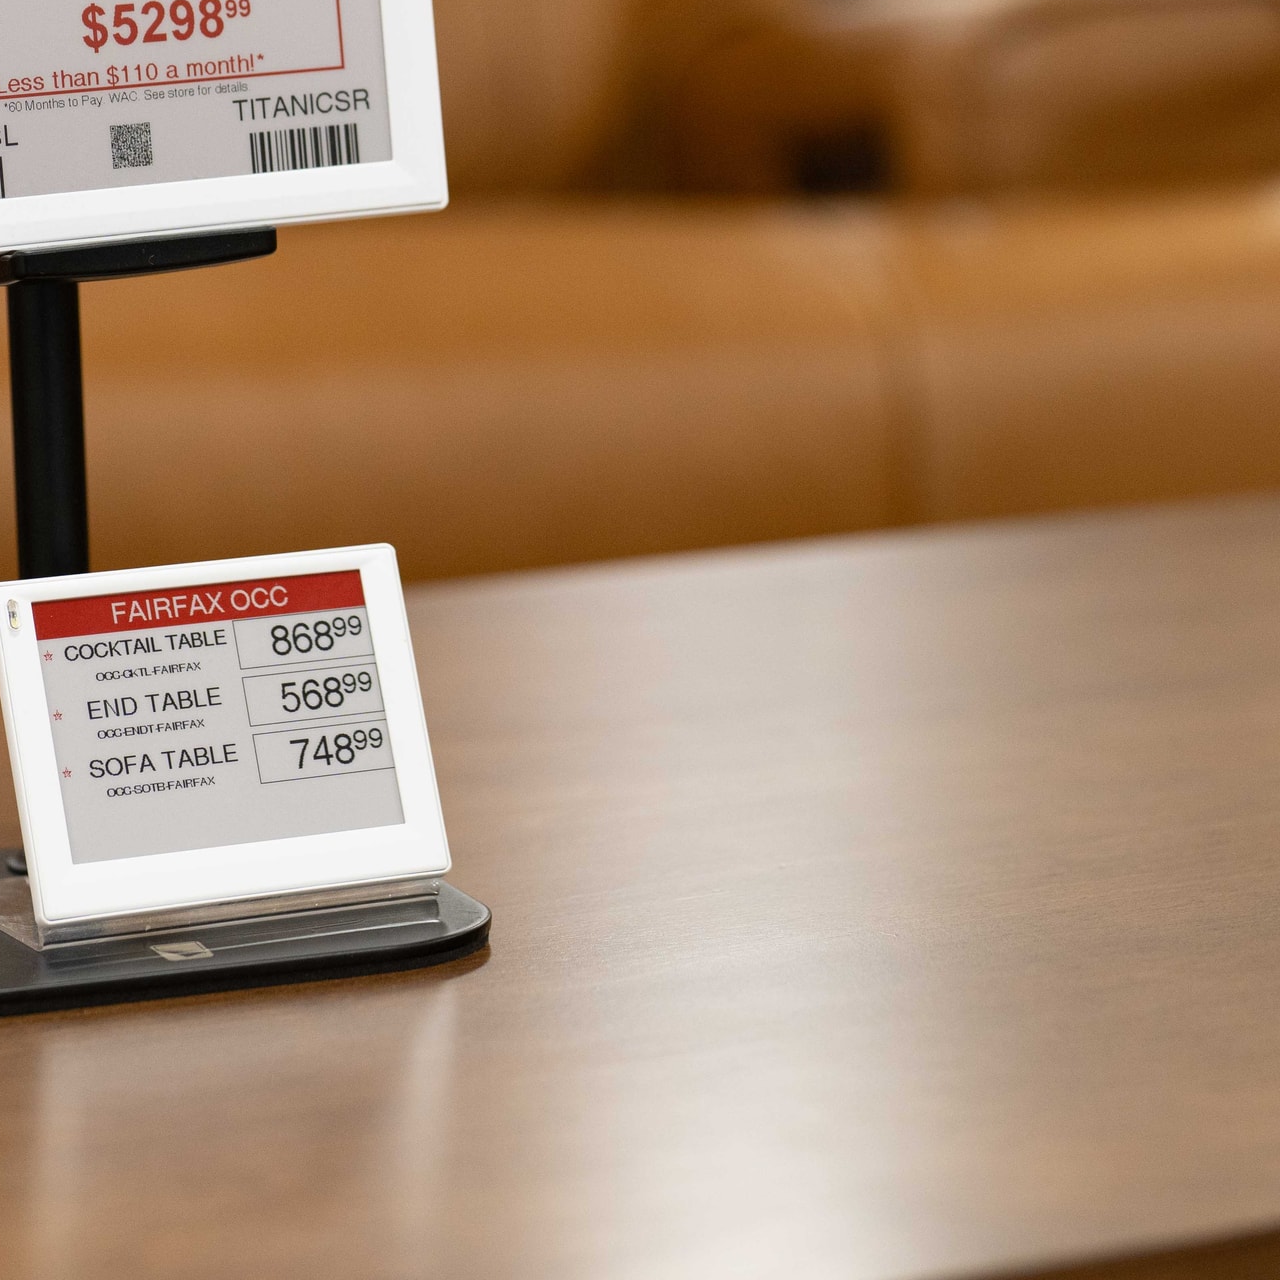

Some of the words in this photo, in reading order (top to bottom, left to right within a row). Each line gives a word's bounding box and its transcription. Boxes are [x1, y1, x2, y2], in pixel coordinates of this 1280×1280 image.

[52, 70, 99, 88] than
[107, 61, 159, 87] $110
[167, 65, 178, 78] a
[25, 99, 65, 110] Months
[68, 98, 78, 107] to
[144, 90, 165, 101] See
[168, 88, 194, 99] store
[198, 85, 211, 95] for
[232, 89, 370, 121] TITANICSR
[112, 592, 225, 624] FAIRFAX
[231, 586, 288, 610] OCC
[64, 637, 162, 661] COCKTAIL
[165, 629, 227, 650] TABLE
[87, 697, 137, 719] END
[145, 687, 222, 712] TABLE
[90, 754, 156, 778] SOFA
[161, 744, 238, 769] TABLE
